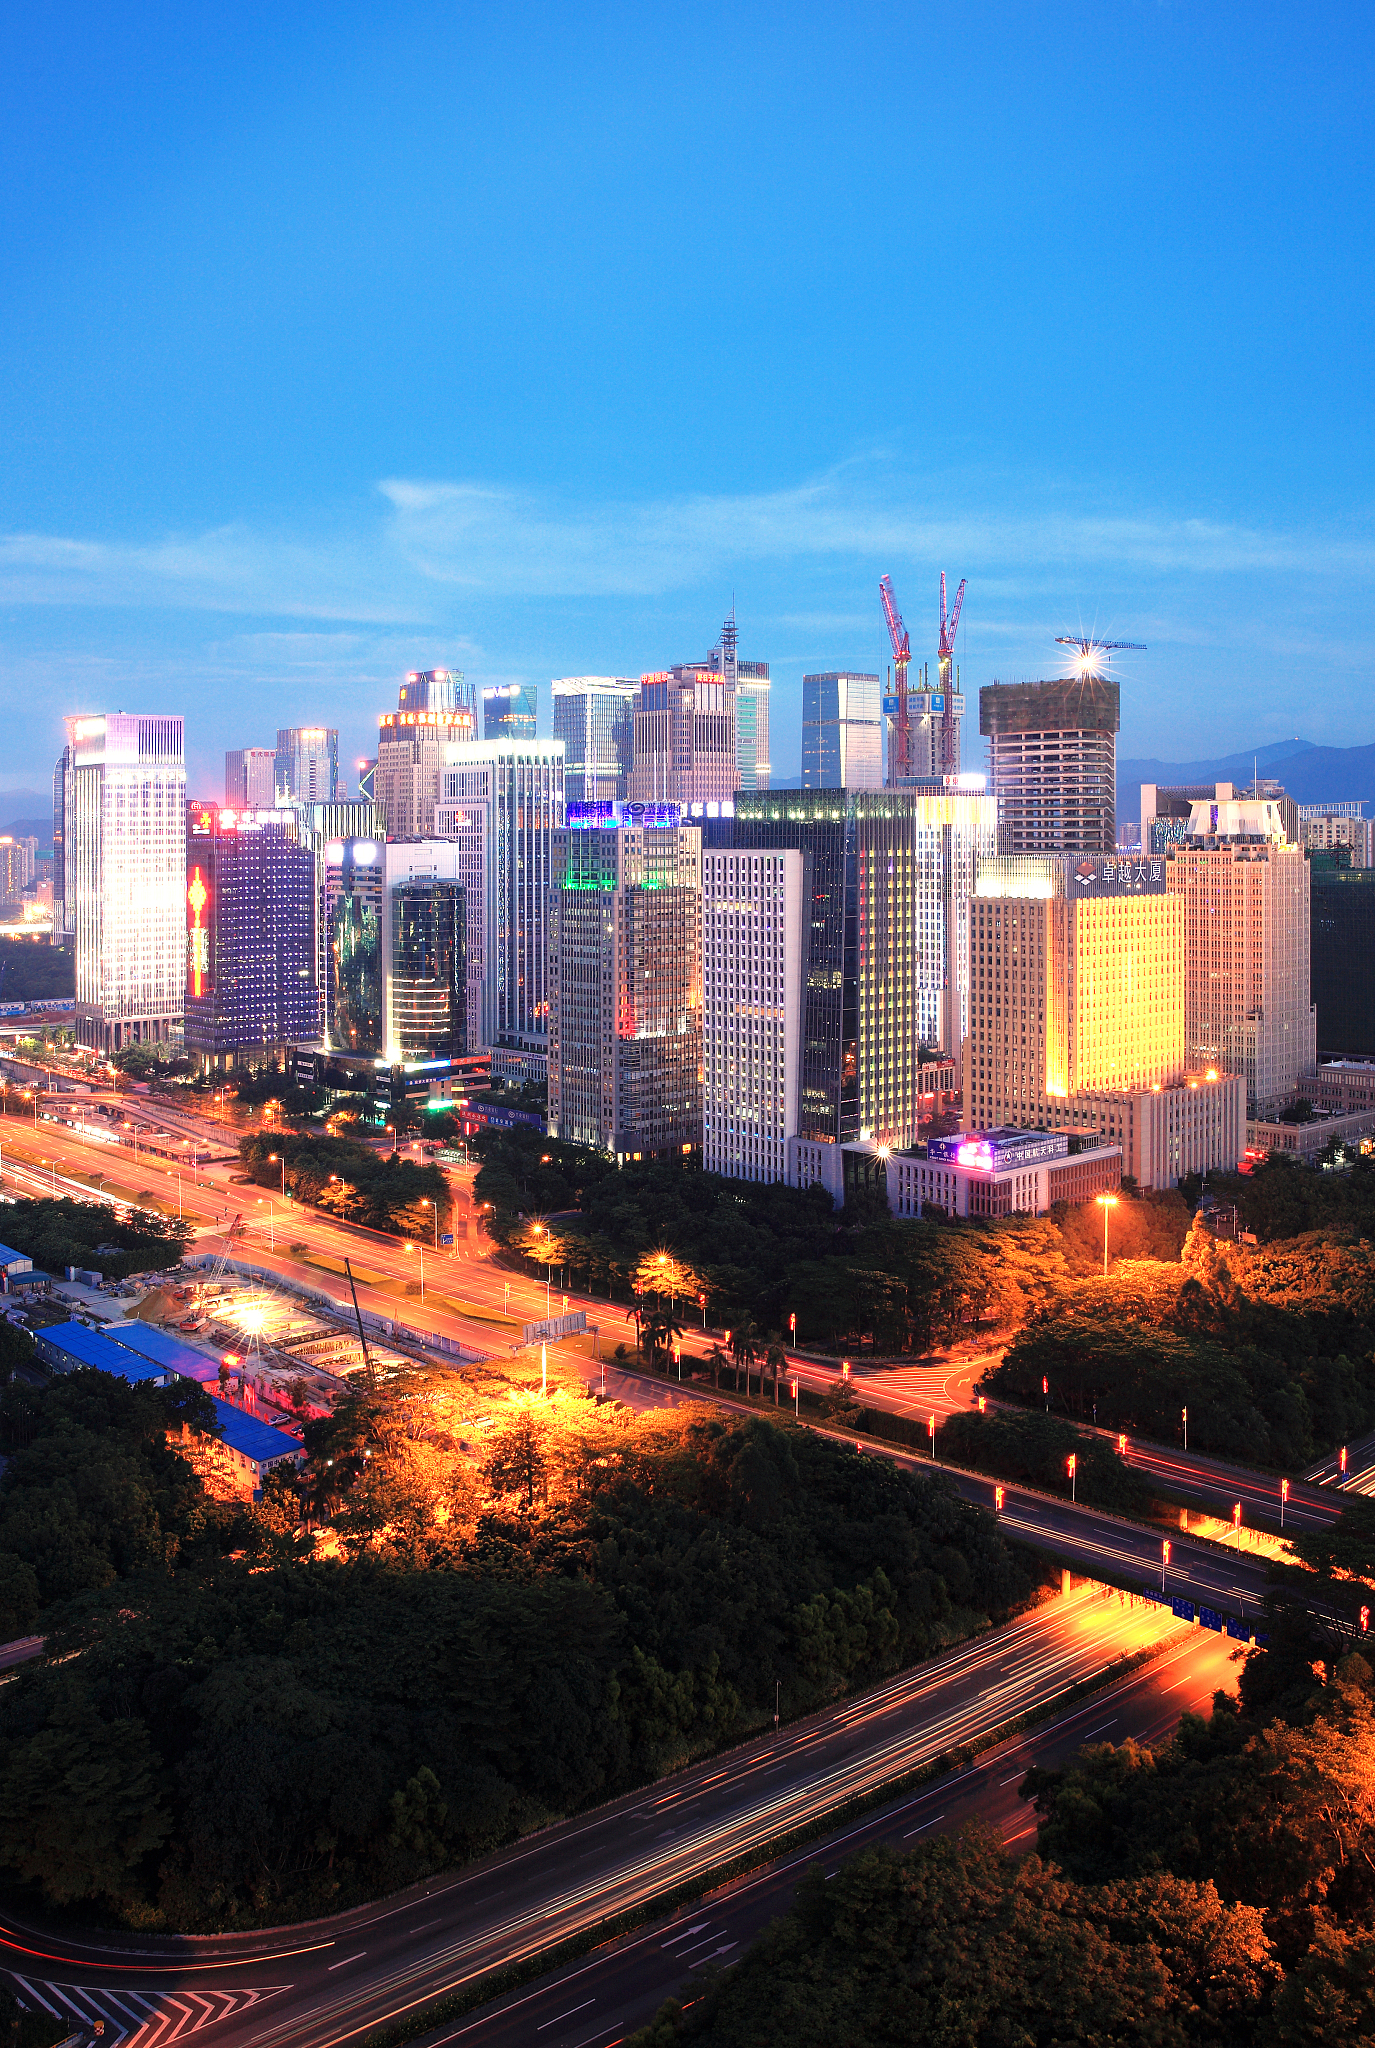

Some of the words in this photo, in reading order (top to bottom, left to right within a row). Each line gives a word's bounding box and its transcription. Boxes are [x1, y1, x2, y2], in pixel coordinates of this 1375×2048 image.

[1102, 861, 1162, 883] 卓越大厦
[1016, 1144, 1062, 1160] 中国航天科工
